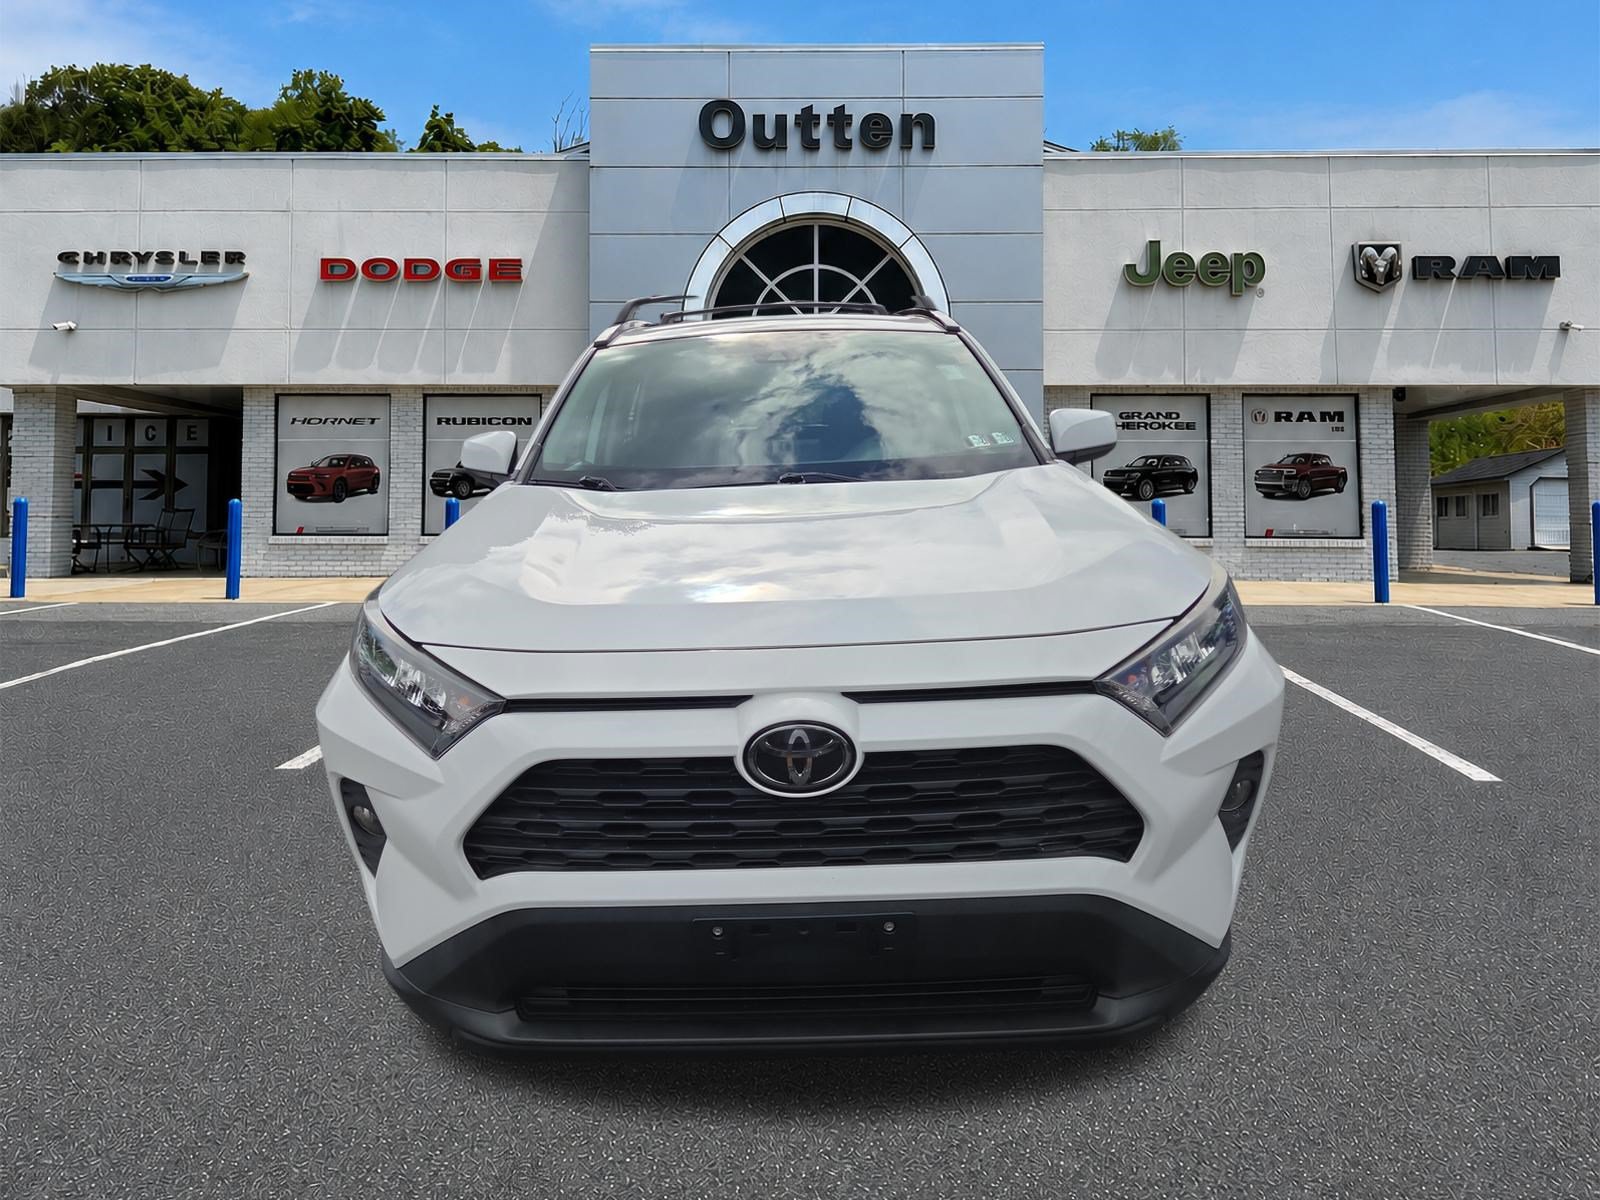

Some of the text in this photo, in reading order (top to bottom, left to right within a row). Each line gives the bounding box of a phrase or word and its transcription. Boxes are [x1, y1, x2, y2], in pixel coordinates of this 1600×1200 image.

[699, 99, 936, 151] Outten
[57, 251, 246, 265] CHRYSLER
[319, 257, 523, 282] DODGE
[1123, 240, 1266, 296] Jeep
[1411, 255, 1561, 280] RAM
[290, 417, 380, 426] HORNET
[436, 416, 532, 426] RUBICON
[1118, 411, 1180, 420] GRAND
[1274, 411, 1345, 423] RAM
[1115, 421, 1197, 431] HEROKEE
